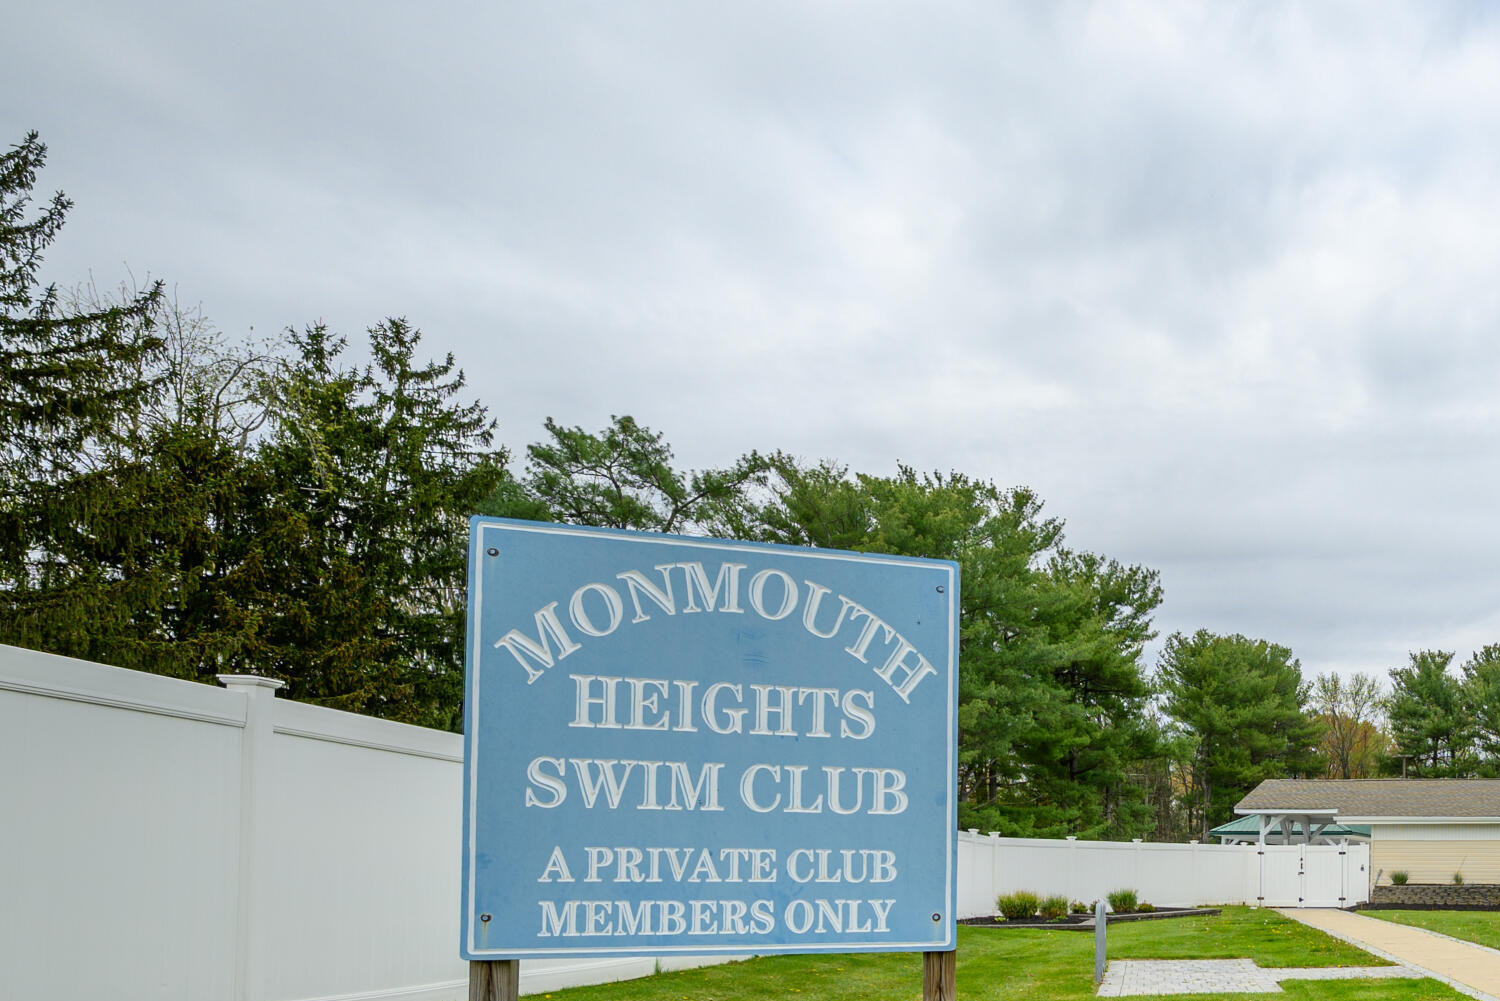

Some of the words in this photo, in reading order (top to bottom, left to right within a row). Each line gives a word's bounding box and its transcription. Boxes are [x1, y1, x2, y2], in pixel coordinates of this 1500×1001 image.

[494, 561, 938, 704] MONMOUTH
[568, 673, 876, 740] HEIGHTS
[525, 755, 725, 812] SWIM
[740, 764, 909, 816] CLUB
[537, 846, 575, 884] A
[584, 847, 777, 884] PRIVATE
[786, 849, 898, 884] CLUB
[537, 900, 776, 938] MEMBERS
[784, 899, 897, 934] ONLY
